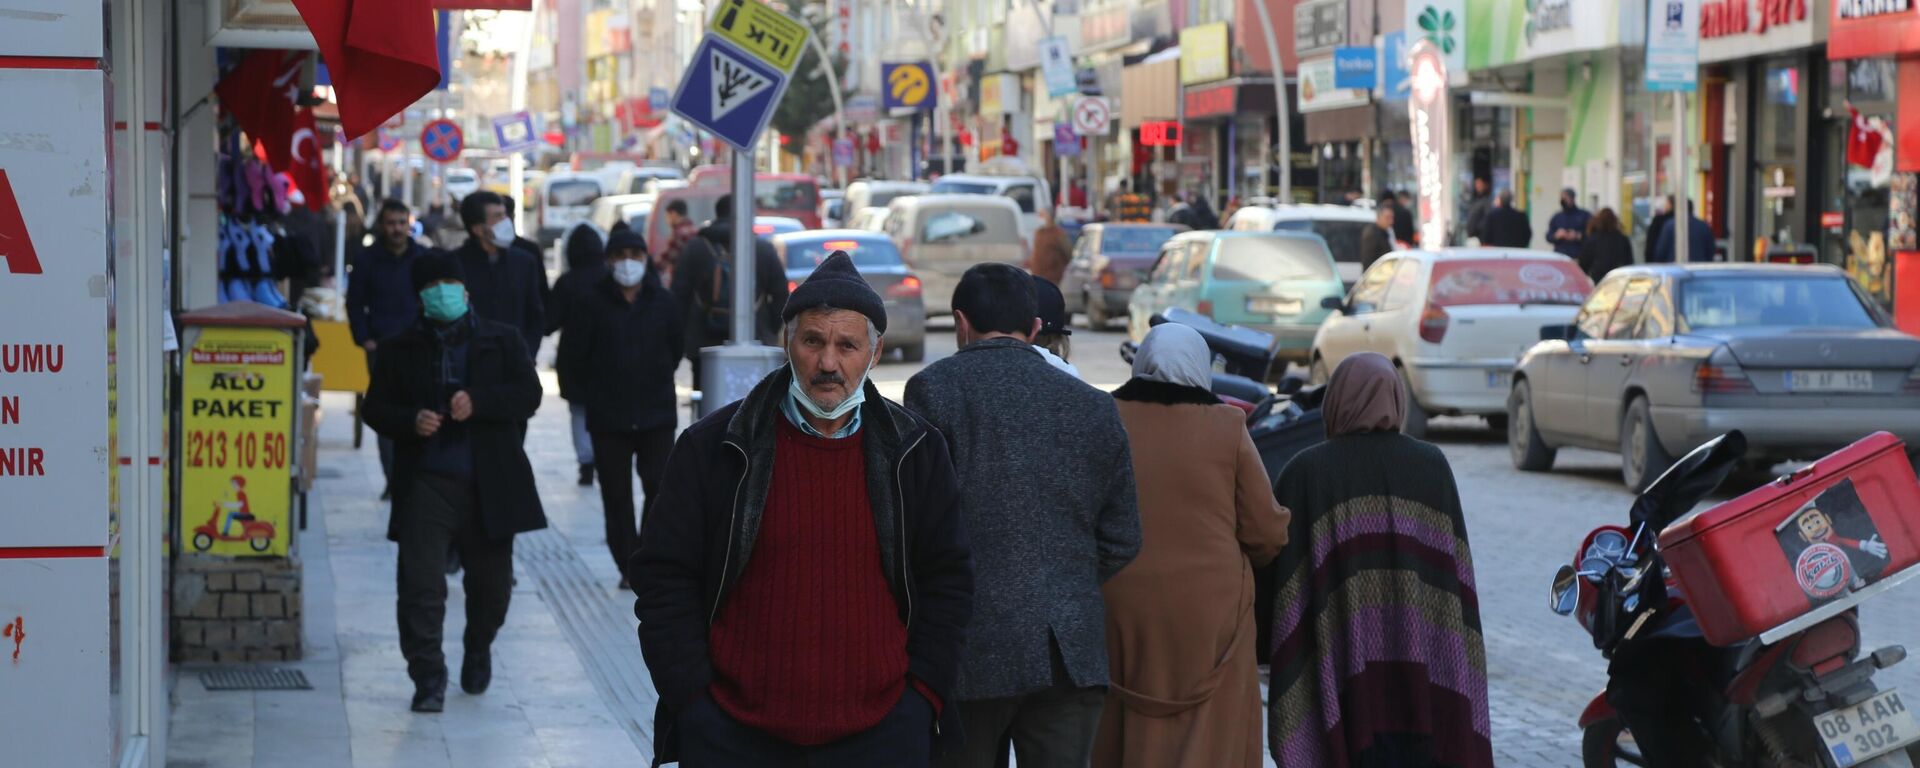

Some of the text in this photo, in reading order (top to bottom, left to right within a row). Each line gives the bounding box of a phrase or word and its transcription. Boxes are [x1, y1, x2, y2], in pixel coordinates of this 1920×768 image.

[0, 343, 64, 374] UMU
[210, 372, 265, 391] ALO
[192, 398, 283, 418] PAKET
[193, 430, 228, 469] 213
[234, 431, 257, 470] 10
[263, 431, 286, 470] 50
[1820, 692, 1906, 740] 08 AAH
[1854, 723, 1900, 753] 302
